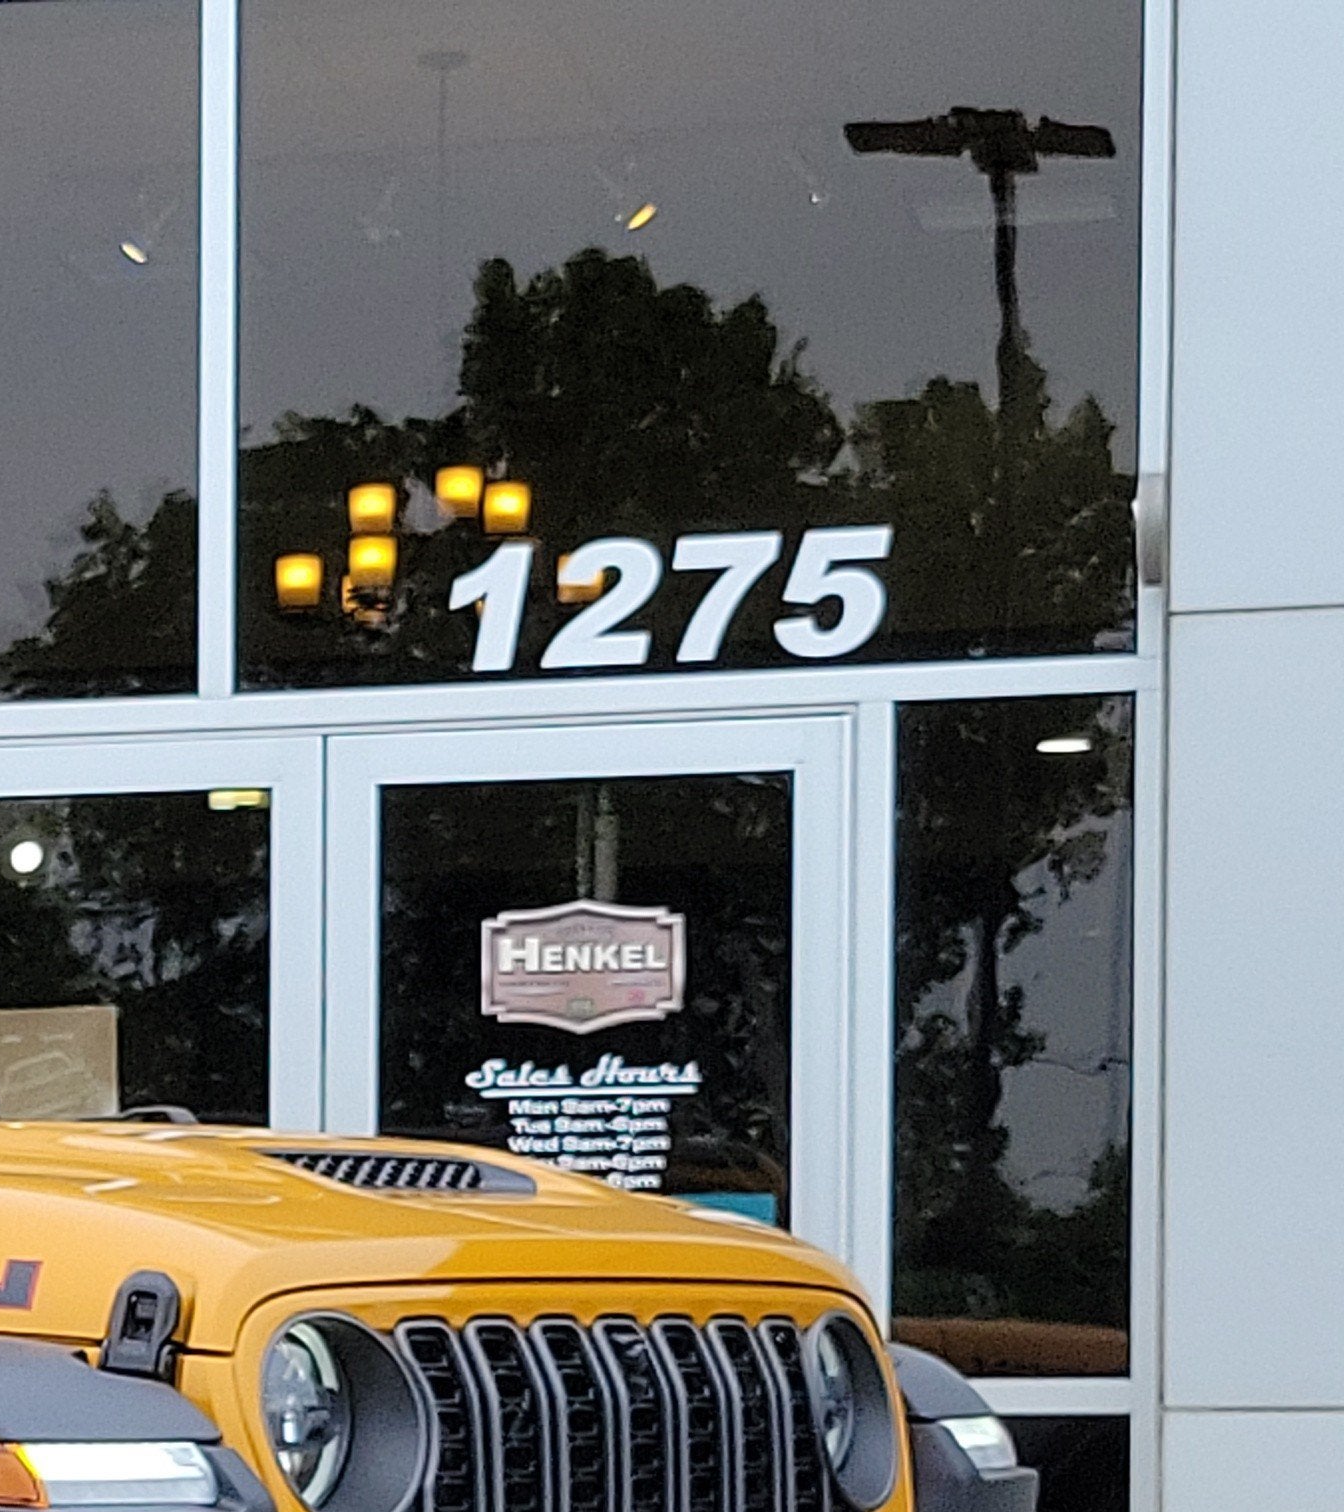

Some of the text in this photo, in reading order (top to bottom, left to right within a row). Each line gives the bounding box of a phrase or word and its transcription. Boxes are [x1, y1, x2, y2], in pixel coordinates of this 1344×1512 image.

[448, 524, 894, 672] 1275
[498, 935, 667, 973] HENKEL
[464, 1052, 703, 1088] Sales Hours
[508, 1099, 560, 1115] Mon
[510, 1117, 553, 1134] Tue
[507, 1136, 560, 1152] Wed
